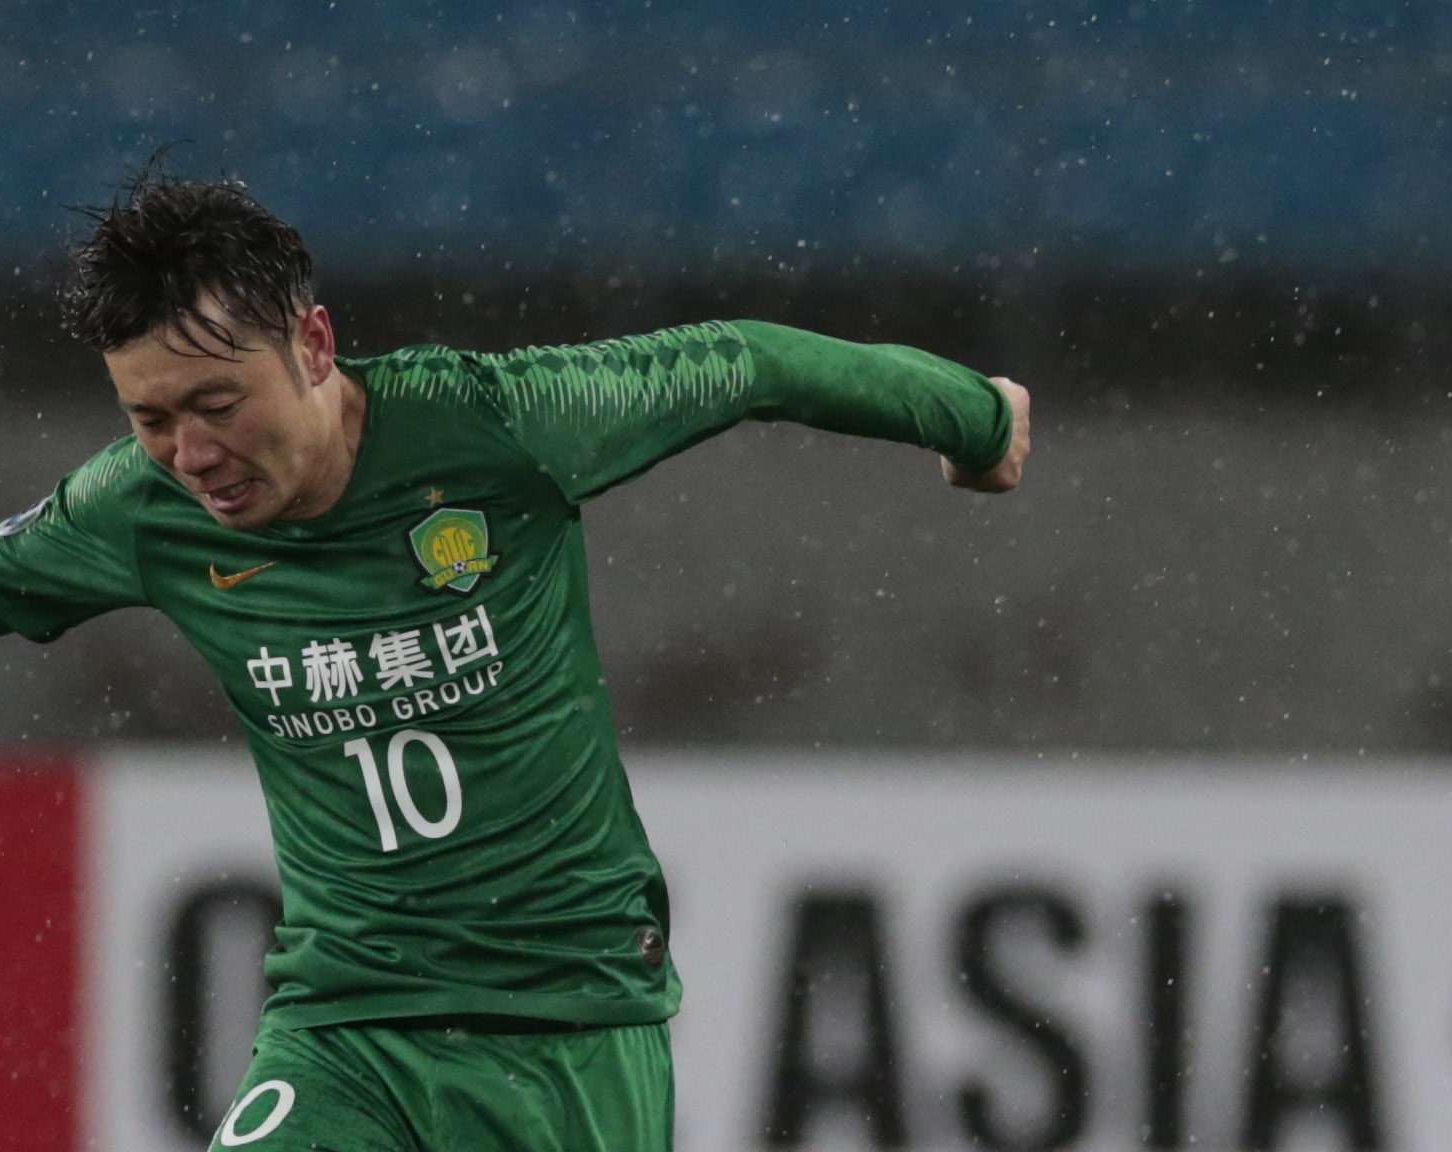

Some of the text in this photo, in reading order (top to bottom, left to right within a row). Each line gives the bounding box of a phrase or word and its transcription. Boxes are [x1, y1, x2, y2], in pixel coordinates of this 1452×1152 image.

[247, 605, 499, 707] 中赫集团
[267, 661, 504, 738] SINOBO GROUP
[344, 729, 463, 851] 10
